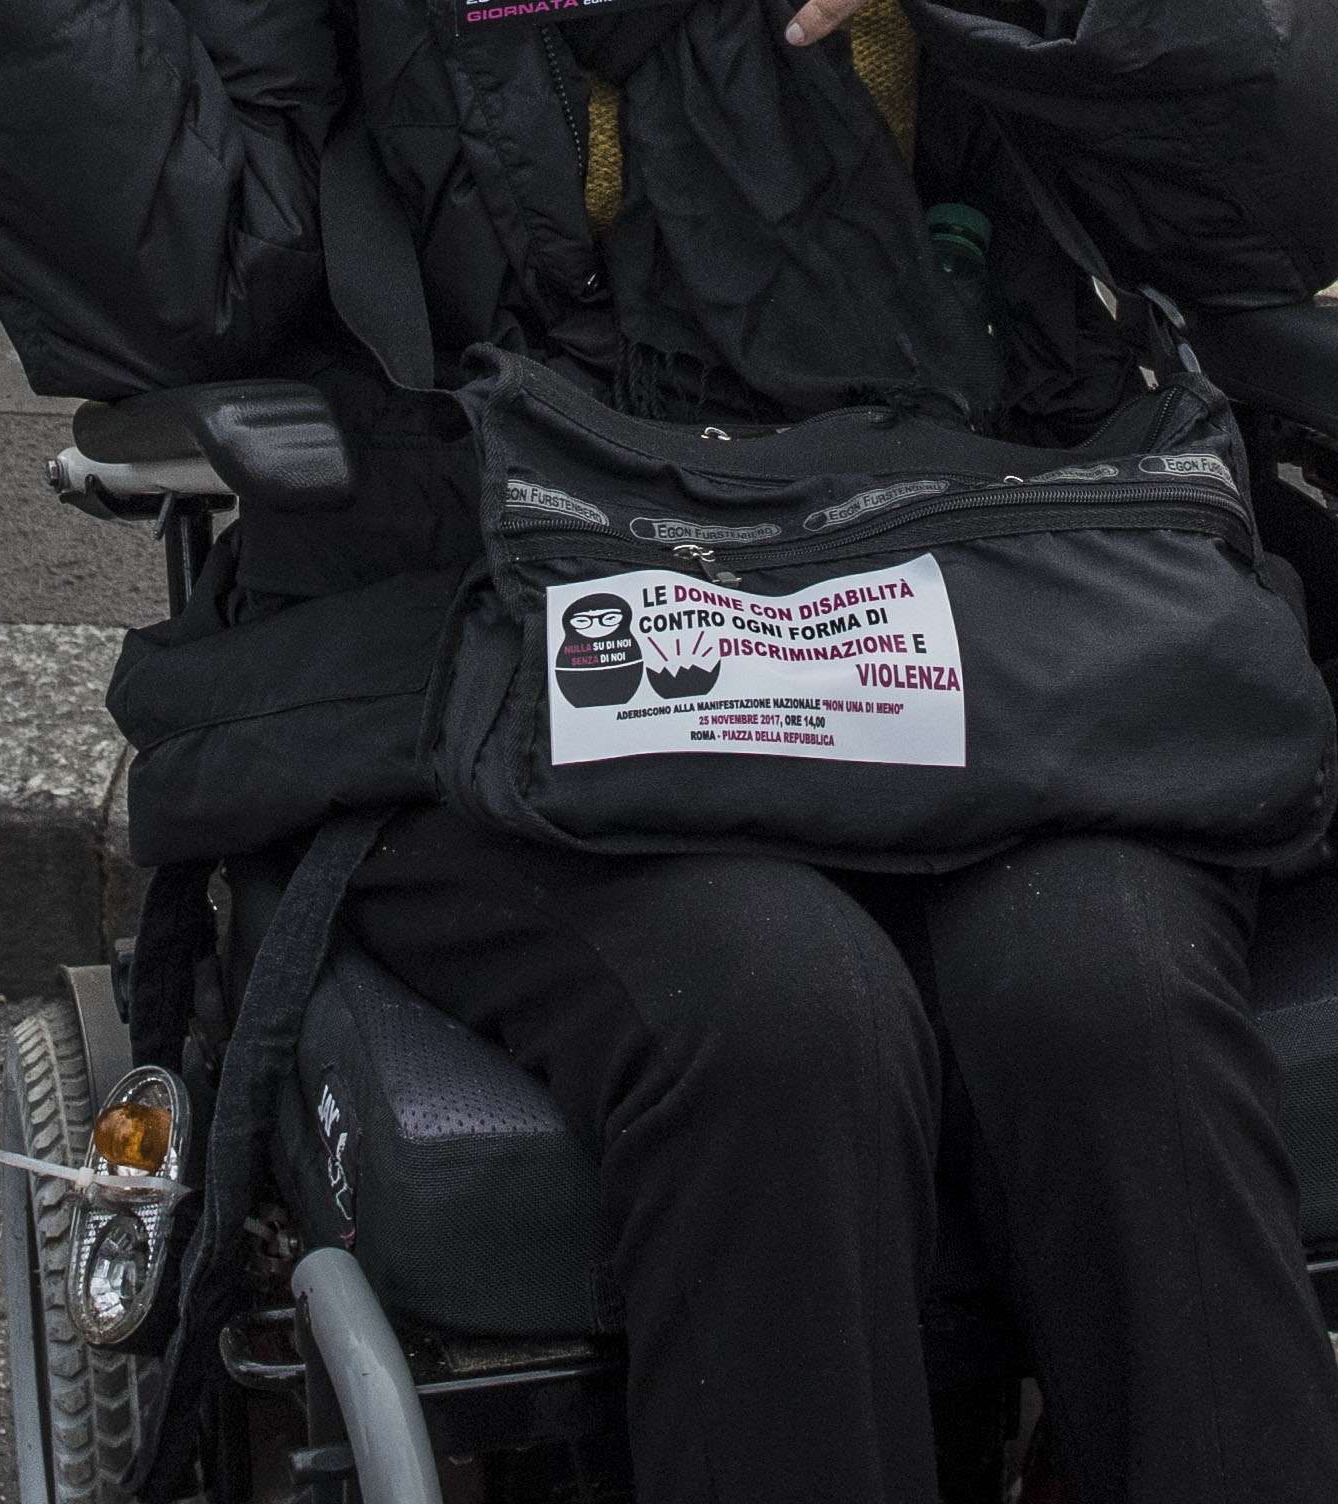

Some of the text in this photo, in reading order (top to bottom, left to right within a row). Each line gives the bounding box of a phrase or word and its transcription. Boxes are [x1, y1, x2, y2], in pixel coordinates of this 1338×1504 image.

[1165, 459, 1199, 471] EGON
[828, 501, 861, 520] EGON
[660, 524, 692, 539] EGON
[642, 578, 915, 621] LE DONNE CON DISABILITÀ
[639, 607, 888, 641] CONTRO OGNI FORMA DI
[564, 638, 632, 654] NULLA SU DI NOI
[719, 633, 927, 662] DISCRIMINAZIONE E
[571, 652, 626, 666] SENZA DI NOI
[855, 663, 961, 691] VIOLENZA
[616, 705, 672, 720] ADERISCONO
[673, 703, 696, 713] ALLA
[697, 698, 771, 711] MANIFESTAZIONE
[773, 698, 821, 710] NAZIONALE
[845, 701, 864, 713] UNA
[865, 701, 874, 713] DI
[699, 715, 710, 725] 25
[711, 714, 759, 725] NOVEMBRE
[760, 714, 783, 728] 2017,
[784, 715, 803, 727] ORE
[690, 730, 716, 741] ROMA
[722, 730, 754, 741] PIAZZA
[755, 730, 782, 743] DELLA
[783, 732, 835, 747] REPUBBLICA
